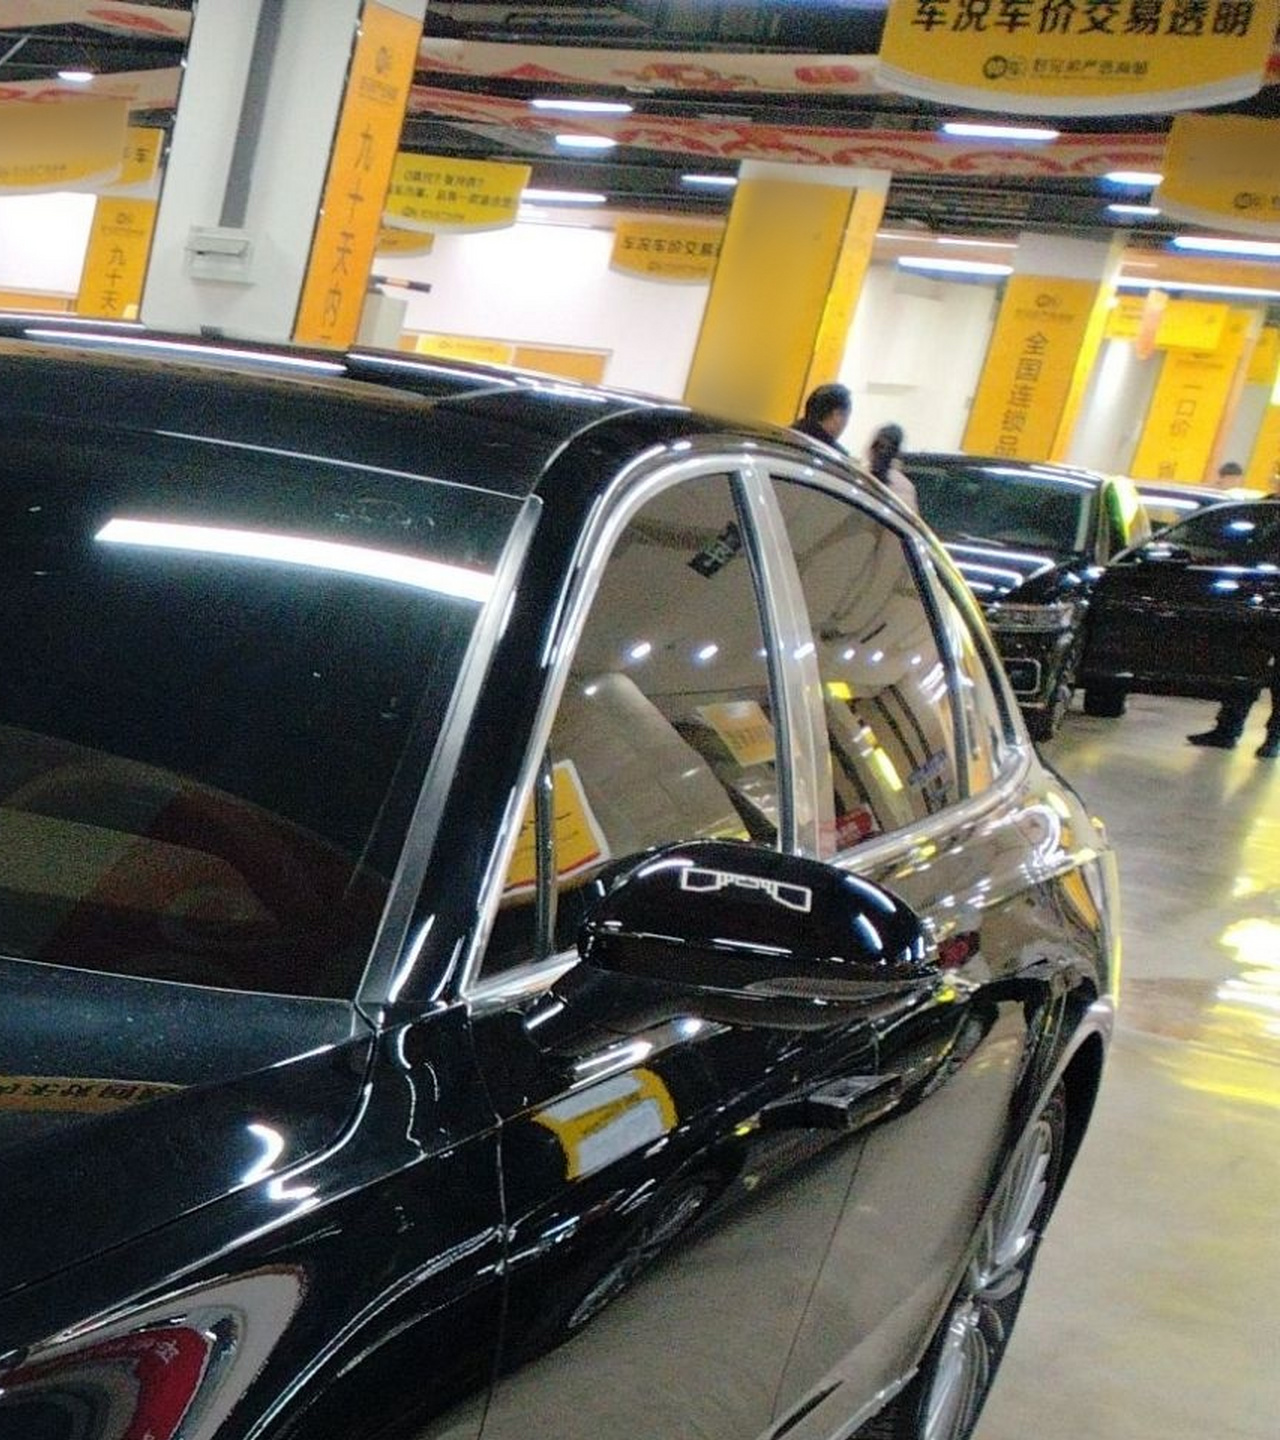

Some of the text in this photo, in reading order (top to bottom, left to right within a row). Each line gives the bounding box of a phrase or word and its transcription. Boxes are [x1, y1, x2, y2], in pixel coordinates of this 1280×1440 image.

[910, 0, 1256, 37] 车况车价交易透明
[319, 122, 373, 339] 九十天内
[622, 235, 721, 258] 车况车价交易
[101, 246, 127, 311] 九十天
